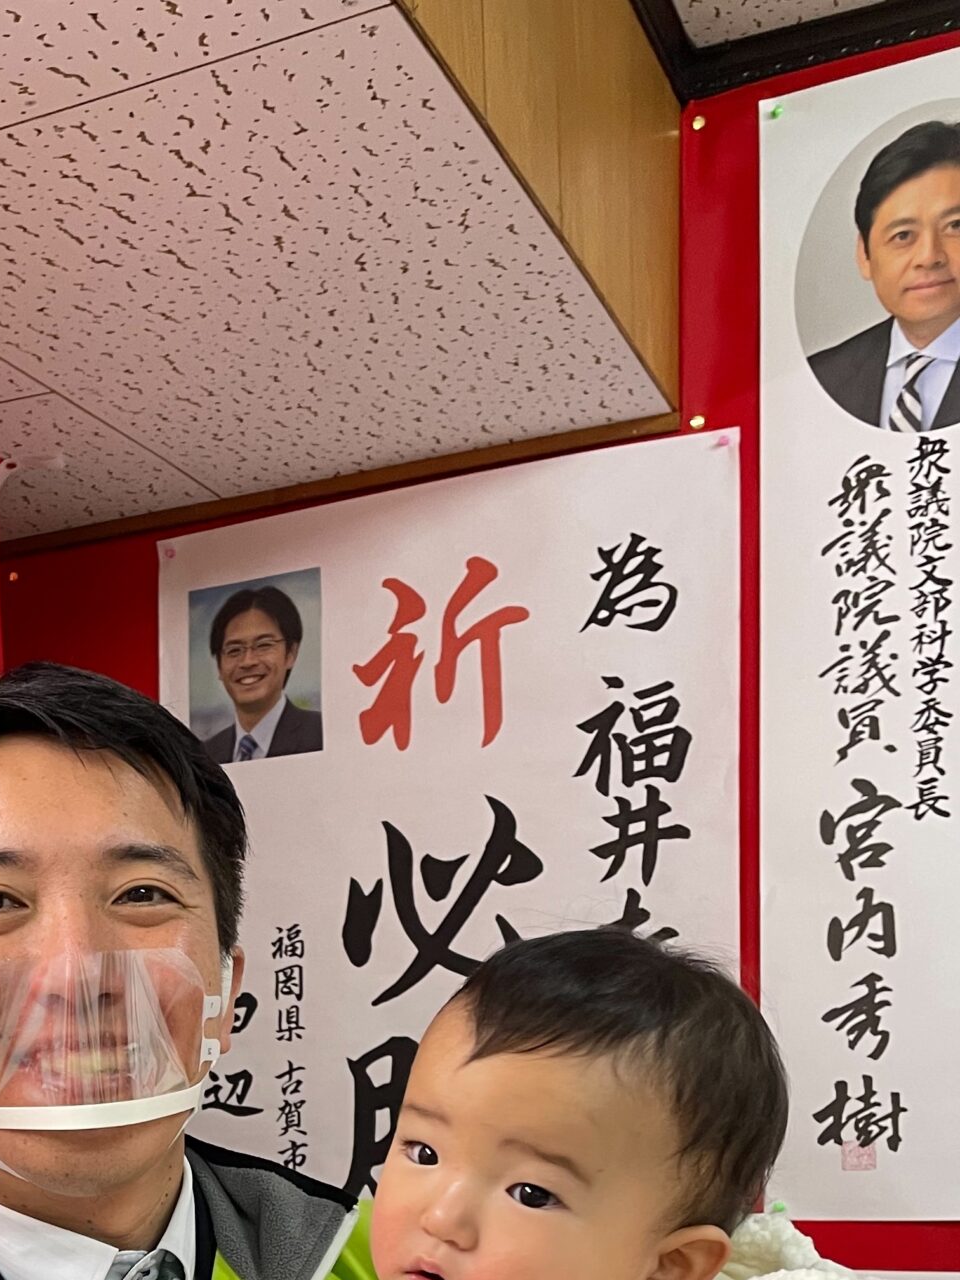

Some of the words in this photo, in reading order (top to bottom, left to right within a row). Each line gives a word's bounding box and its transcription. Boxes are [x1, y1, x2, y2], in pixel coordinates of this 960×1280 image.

[351, 556, 530, 750] 祈
[818, 455, 902, 767] 衆議院議員
[905, 435, 954, 821] 衆議院文部科学委員長
[270, 923, 305, 1042] 福岡県
[274, 1059, 309, 1172] 古賀市
[341, 794, 544, 1200] 必
[811, 777, 909, 1153] 宮内秀樹
